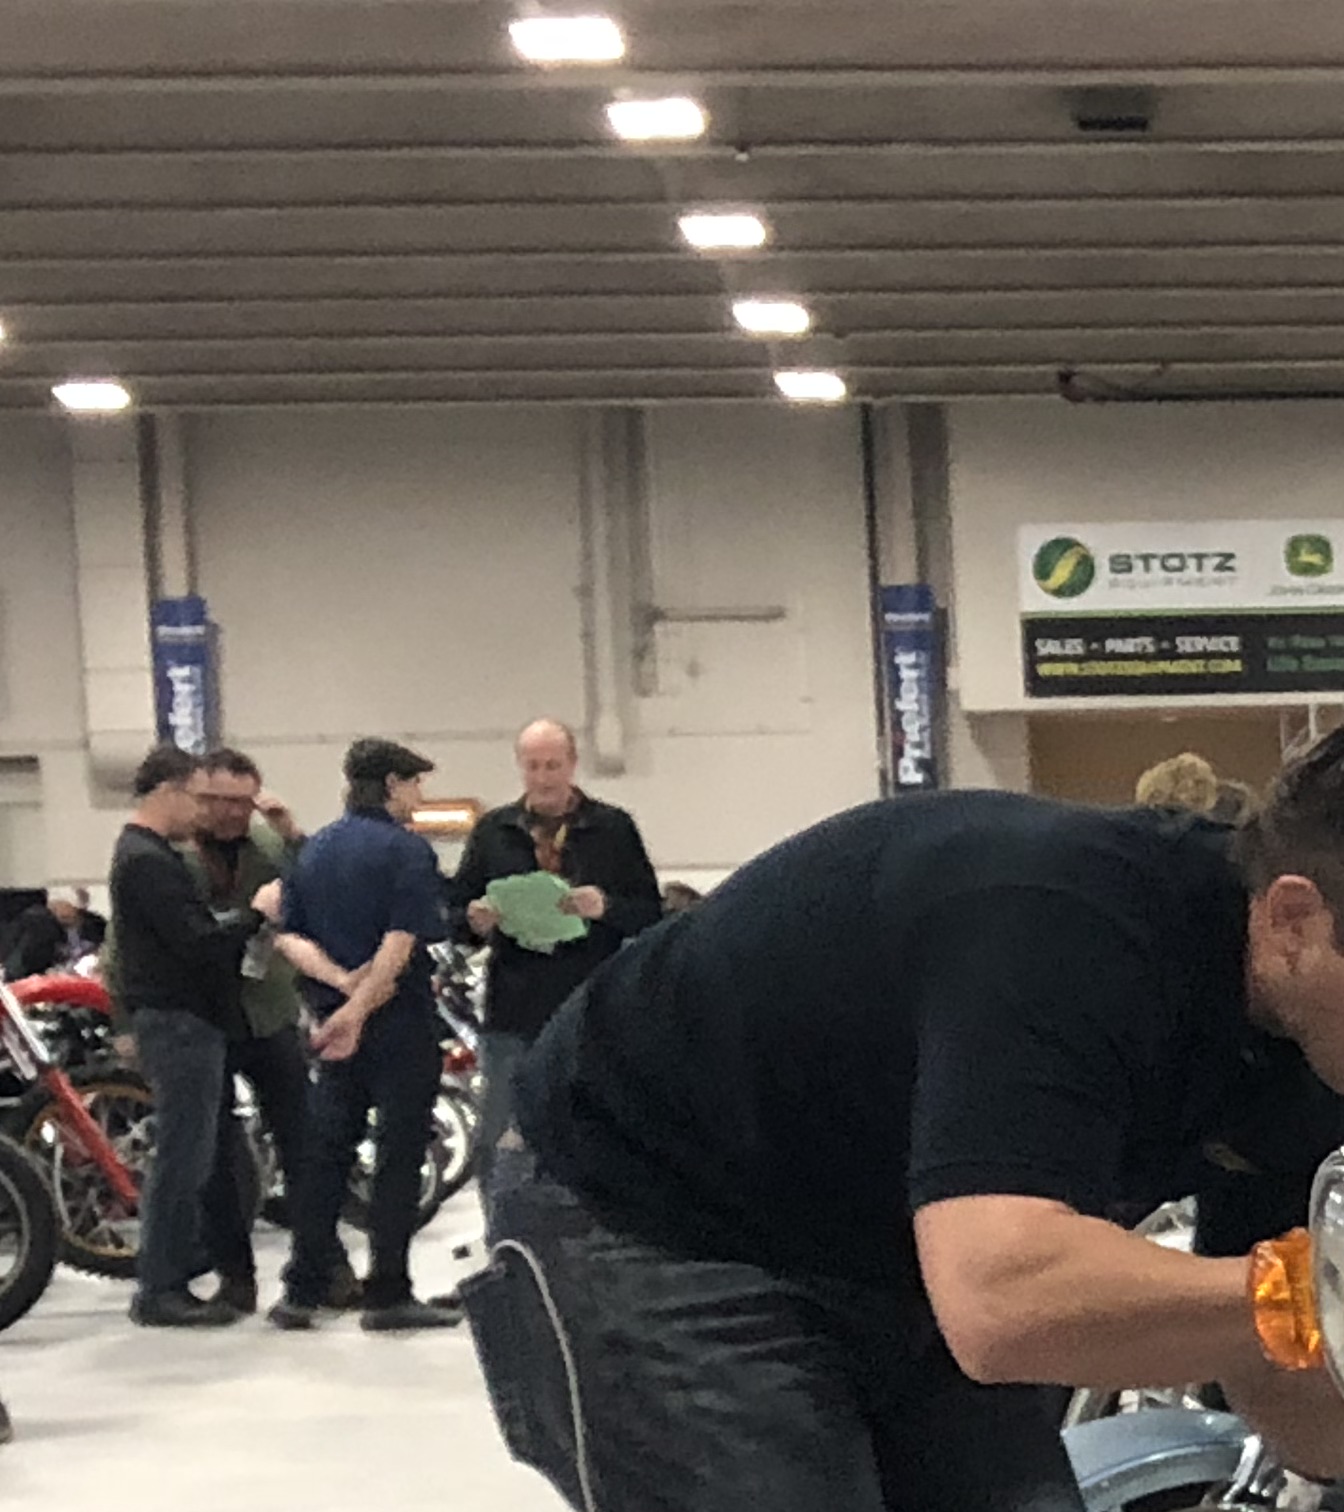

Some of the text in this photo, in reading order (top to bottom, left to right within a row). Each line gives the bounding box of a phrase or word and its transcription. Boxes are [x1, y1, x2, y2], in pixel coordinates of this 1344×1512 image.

[1108, 552, 1236, 574] STOTZ
[1034, 638, 1084, 656] SALES
[1175, 635, 1240, 653] SERVICE
